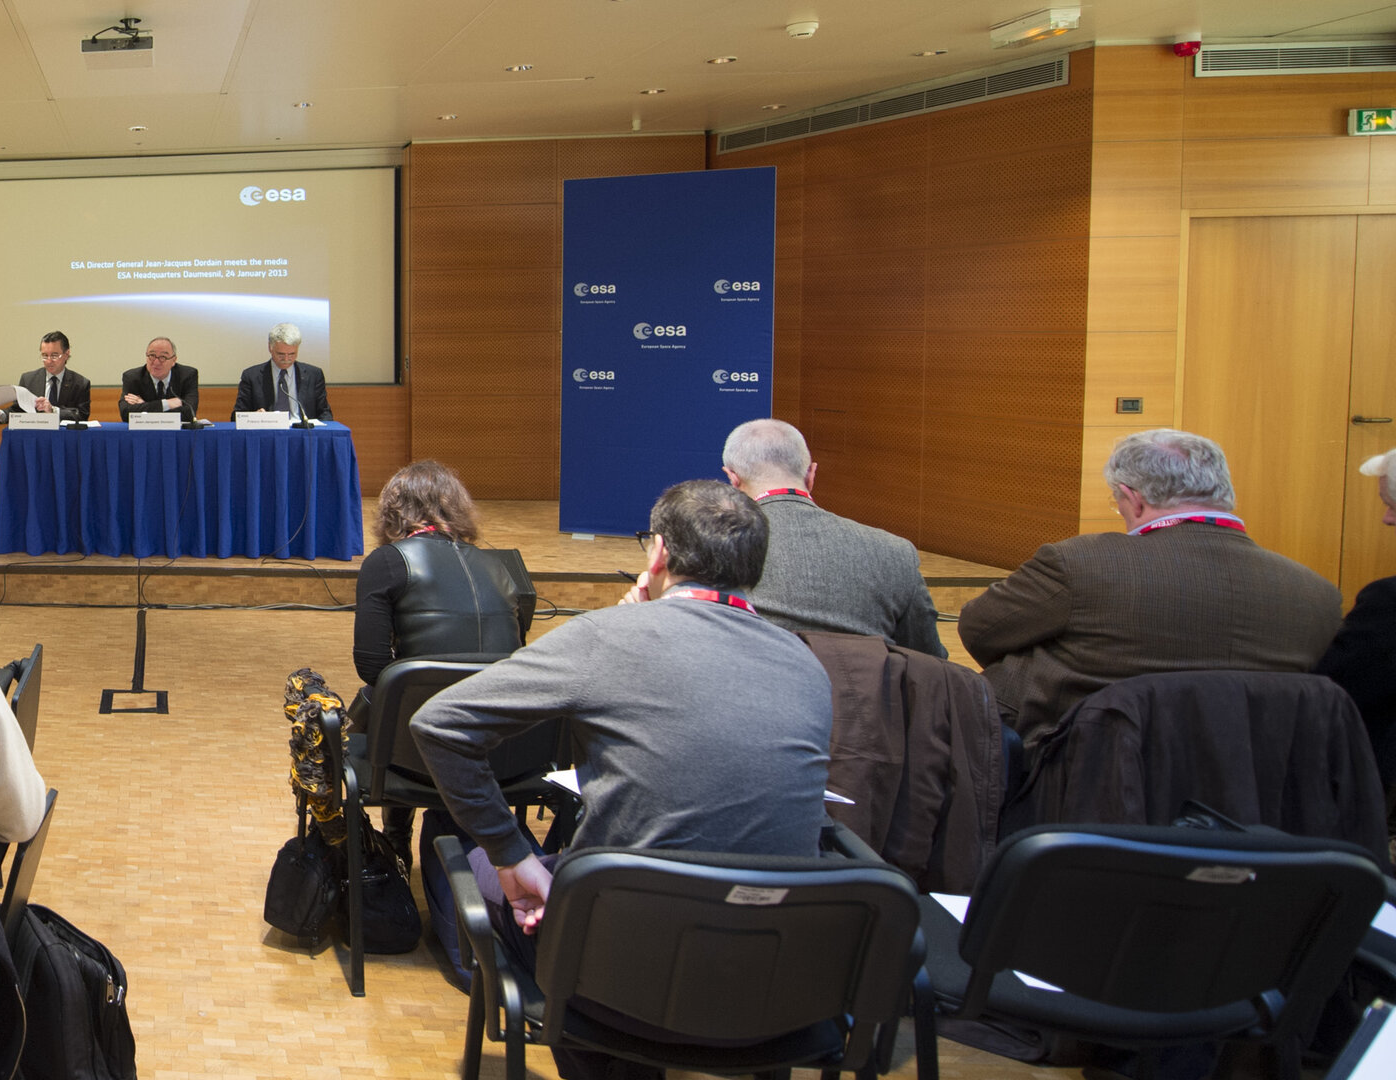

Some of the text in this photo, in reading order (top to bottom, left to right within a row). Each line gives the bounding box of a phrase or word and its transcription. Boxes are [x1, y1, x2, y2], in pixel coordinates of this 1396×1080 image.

[265, 188, 306, 202] esa
[87, 261, 114, 269] Director
[116, 260, 144, 268] General
[145, 259, 192, 268] Jean-Jacques
[193, 259, 222, 267] Dordain
[249, 258, 262, 266] the
[264, 258, 288, 266] media
[117, 271, 132, 280] ESA
[133, 271, 181, 280] Headquarters
[183, 270, 224, 278] Daumesnil,
[237, 269, 266, 278] January
[267, 269, 288, 277] 2013
[590, 285, 616, 294] esa
[732, 281, 761, 291] esa
[654, 325, 687, 337] esa
[589, 371, 615, 380] esa
[730, 372, 759, 382] esa
